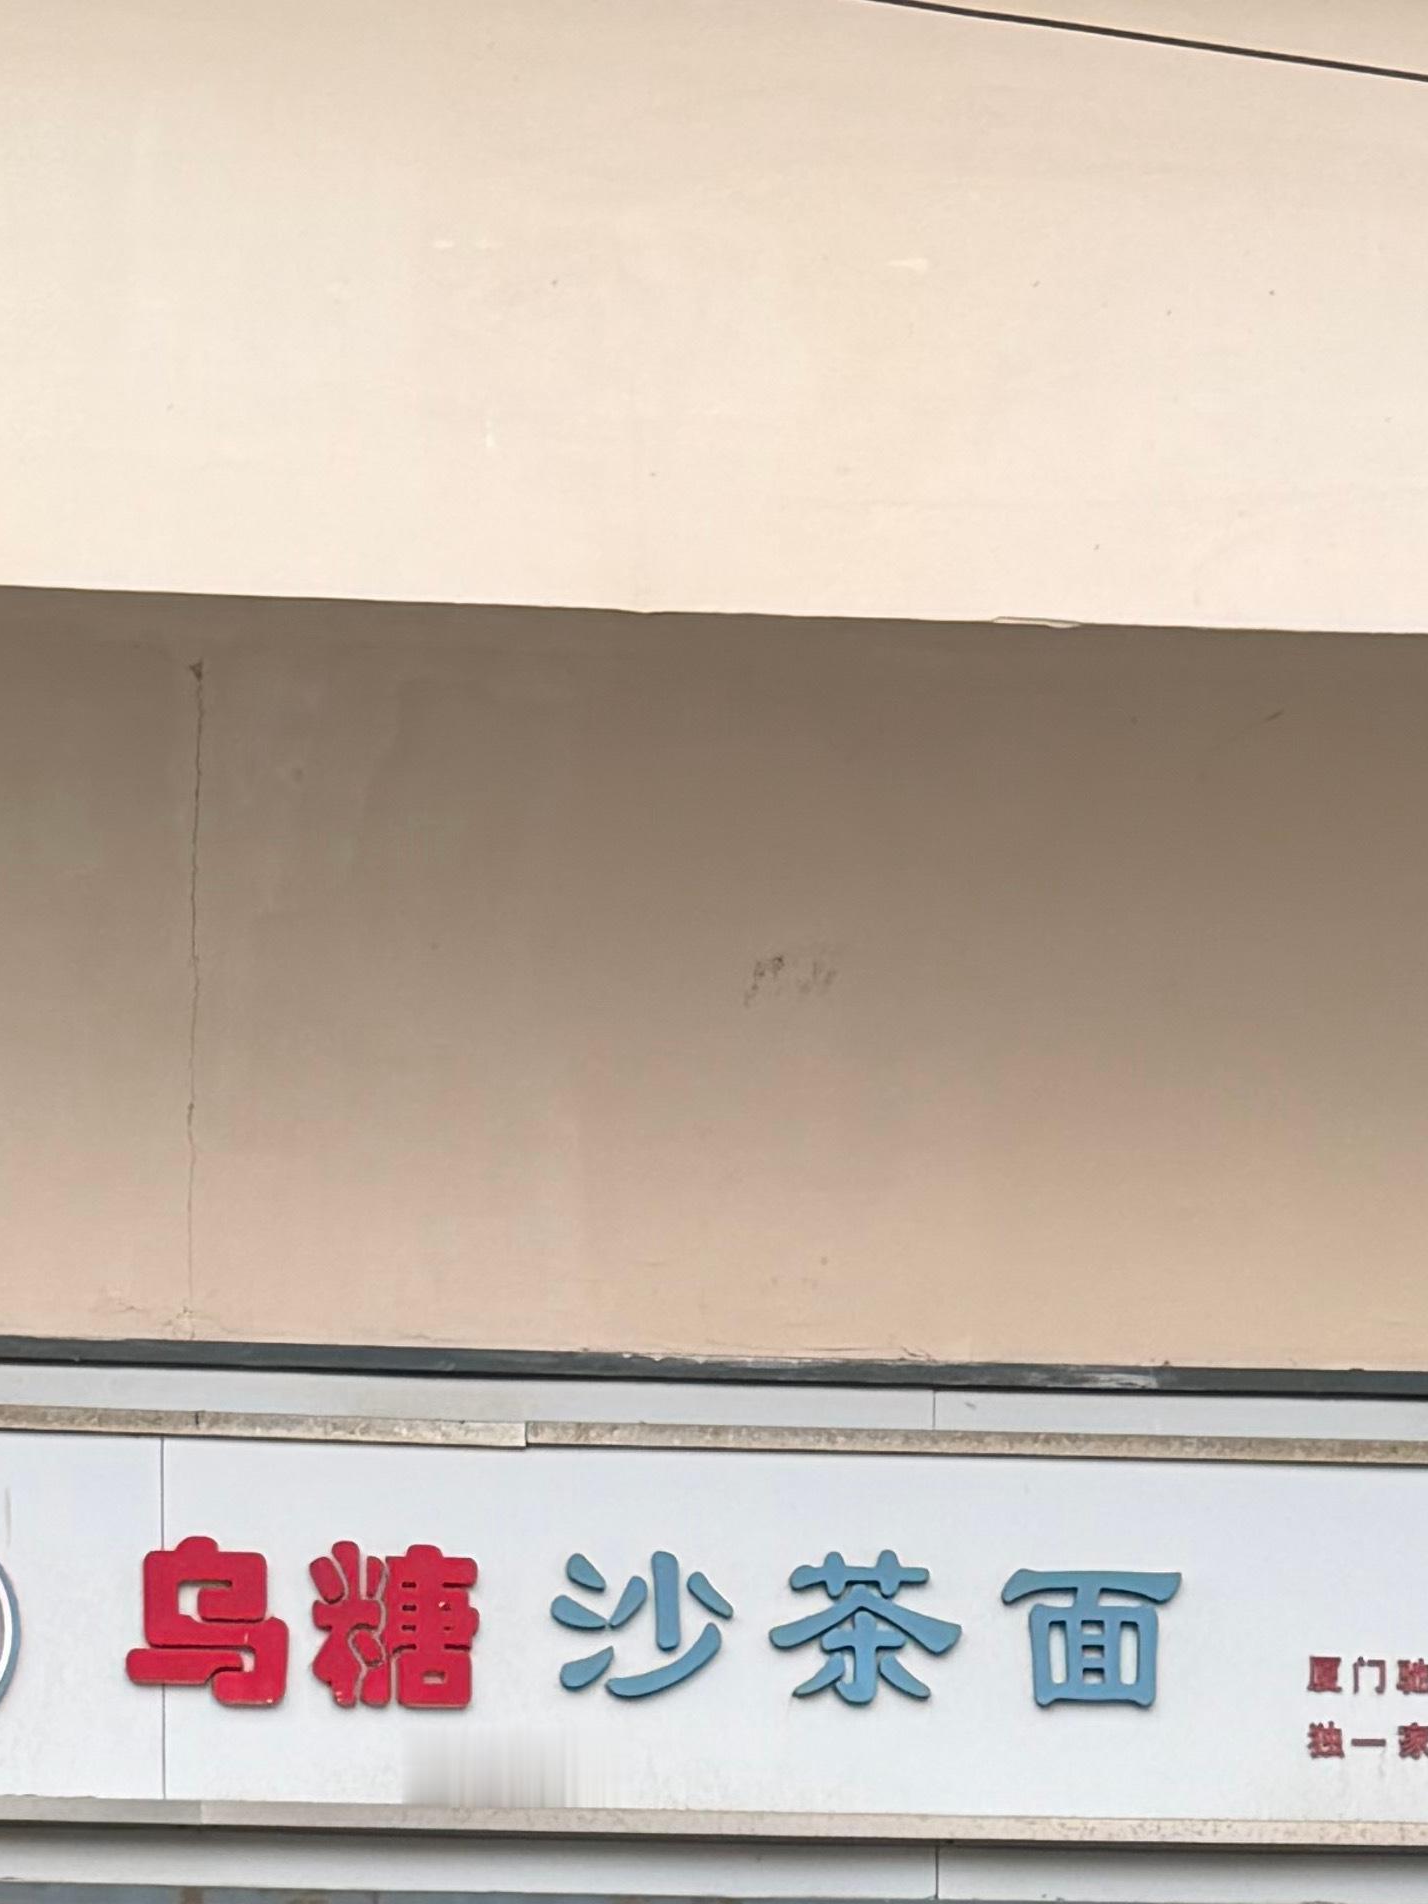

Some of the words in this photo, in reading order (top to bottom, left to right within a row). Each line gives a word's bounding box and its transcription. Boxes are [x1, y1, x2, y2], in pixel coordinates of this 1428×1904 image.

[125, 1535, 480, 1708] 乌糖
[551, 1550, 1181, 1709] 沙茶面
